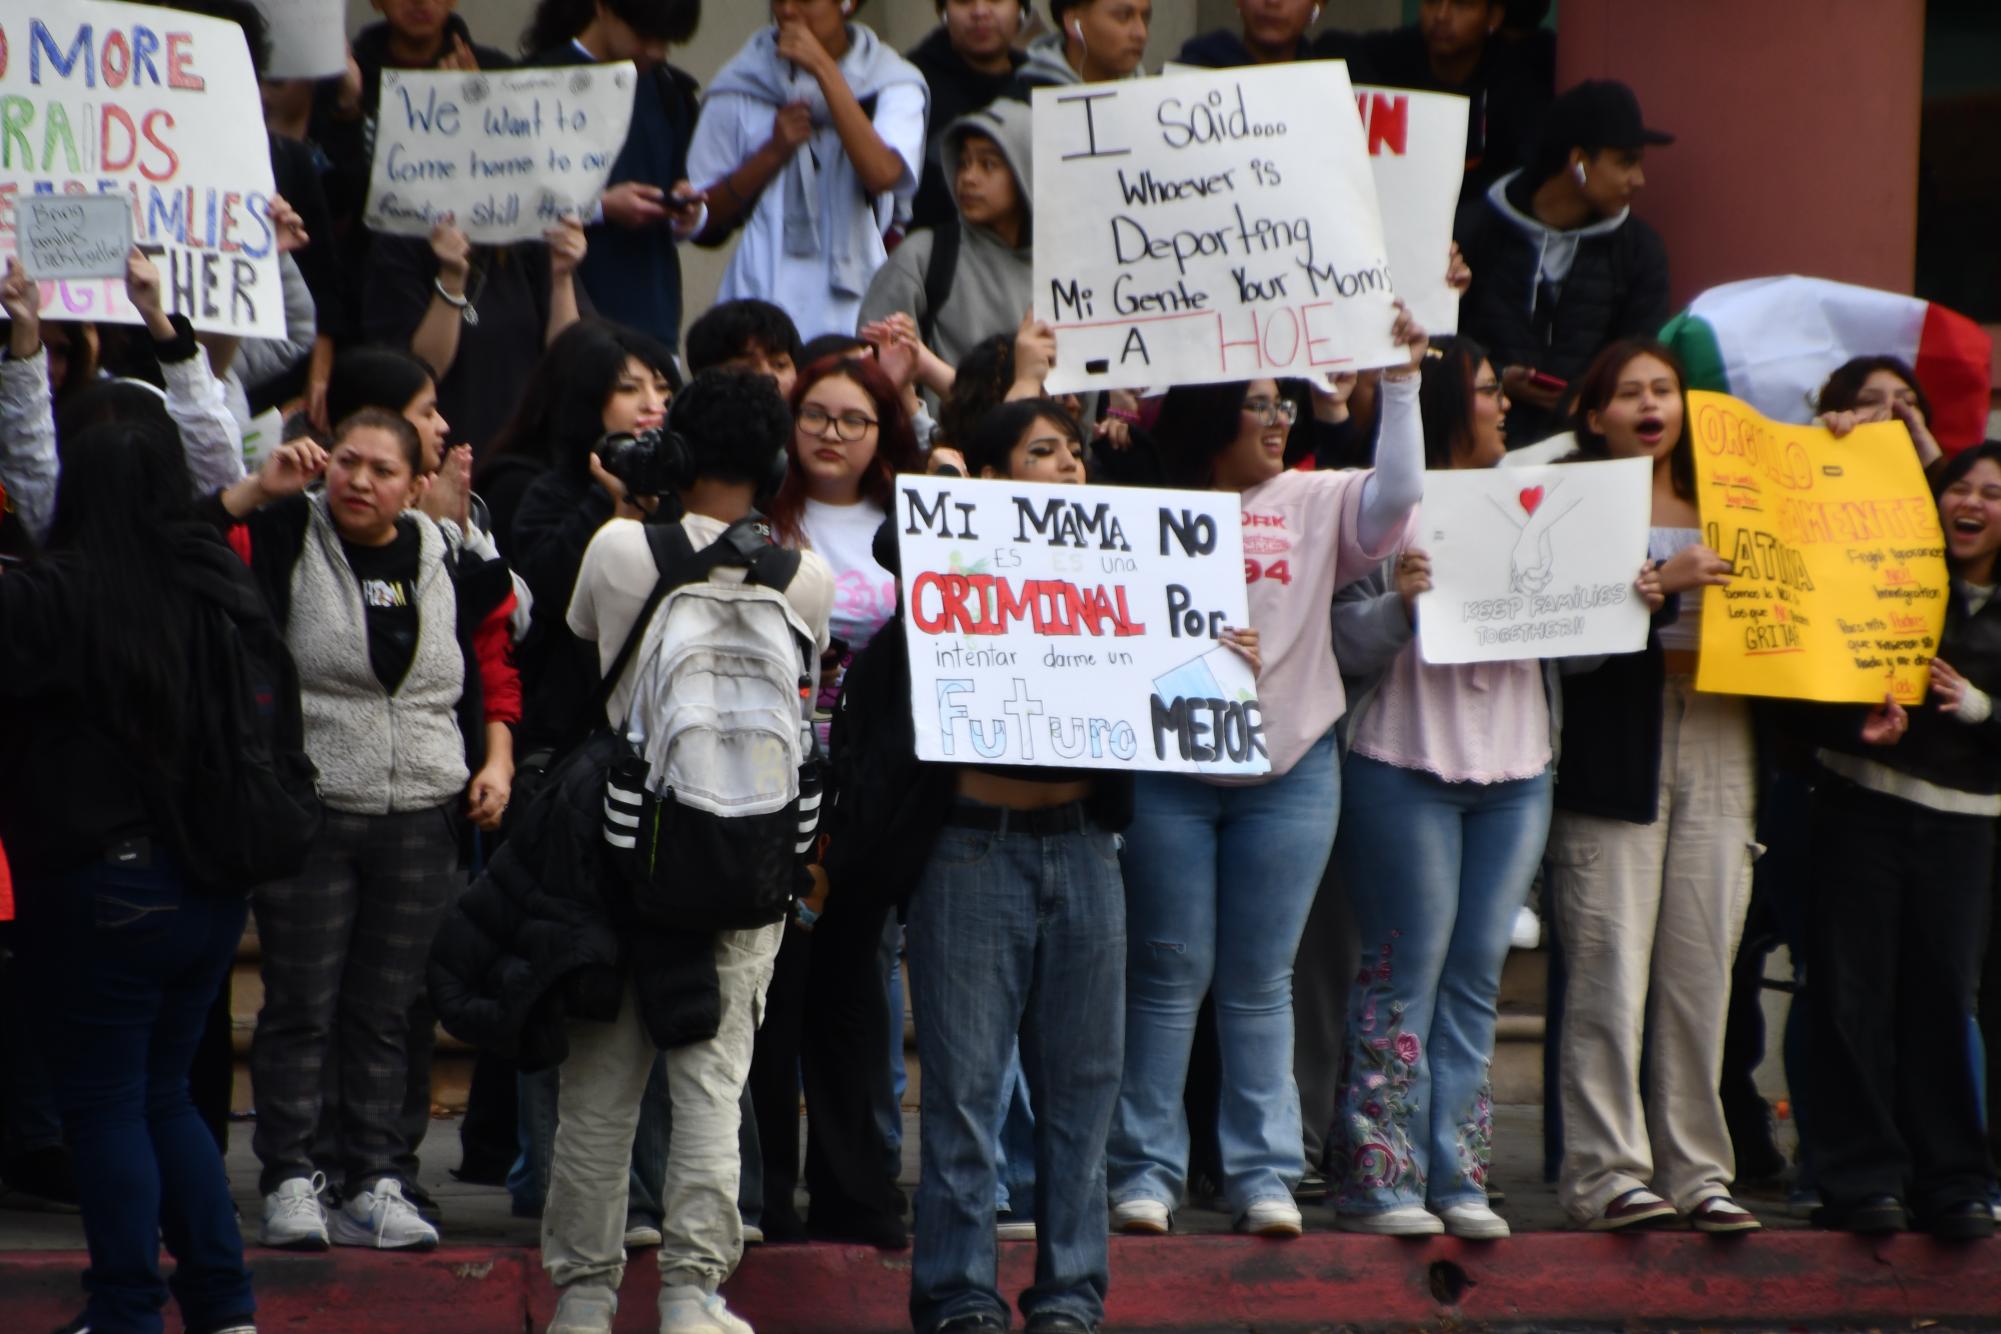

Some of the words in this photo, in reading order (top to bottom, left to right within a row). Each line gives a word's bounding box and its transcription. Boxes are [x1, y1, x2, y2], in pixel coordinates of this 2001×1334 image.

[29, 18, 205, 92] MORE
[1, 94, 178, 181] RAIDS
[398, 85, 460, 136] We
[557, 98, 587, 131] to
[1057, 91, 1132, 162] I
[470, 150, 534, 178] home
[547, 149, 572, 172] to
[1117, 167, 1236, 206] Whoever
[1250, 158, 1282, 187] is
[471, 193, 519, 227] still
[1111, 203, 1313, 276] Deporting
[1051, 278, 1093, 321] Mi
[1113, 273, 1209, 316] Gente
[1231, 266, 1288, 304] Your
[1120, 326, 1151, 366] A
[1217, 301, 1354, 373] HOE
[902, 488, 979, 541] MI
[1012, 496, 1132, 552] MAMA
[1158, 507, 1218, 558] NO
[993, 547, 1022, 569] ES
[911, 570, 1146, 637] CRIMINAL
[1165, 583, 1227, 639] Por
[1463, 599, 1522, 623] KEEP
[936, 641, 1017, 668] intentar
[1043, 644, 1097, 668] darme
[1108, 652, 1133, 666] un
[936, 677, 1137, 761] Futuro
[1150, 692, 1270, 763] MEJOR
